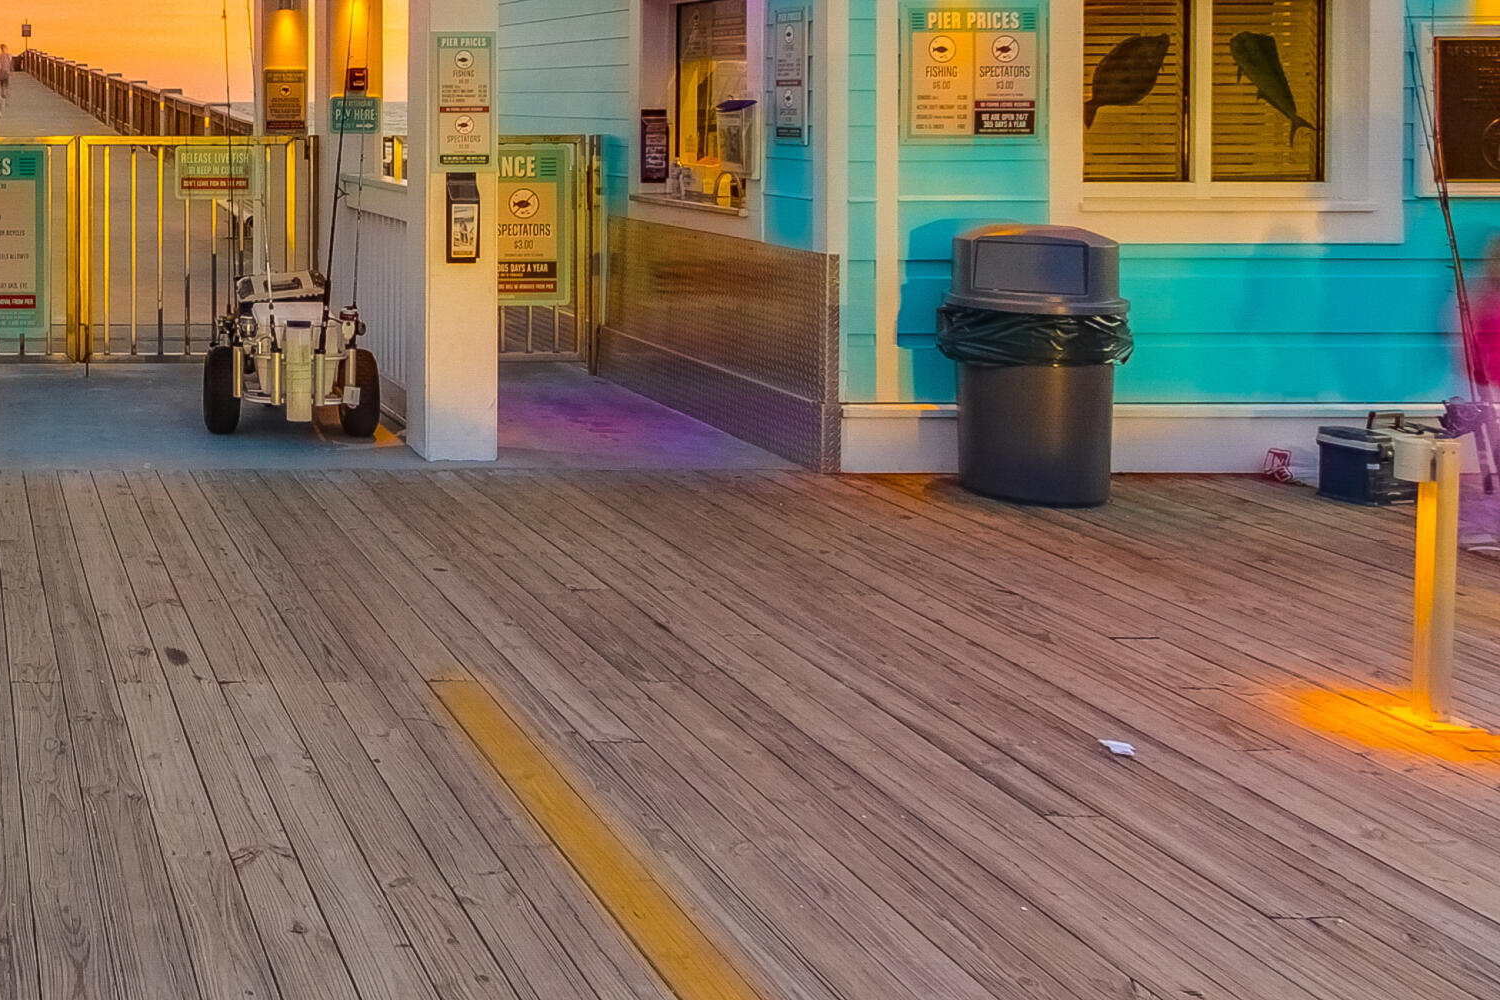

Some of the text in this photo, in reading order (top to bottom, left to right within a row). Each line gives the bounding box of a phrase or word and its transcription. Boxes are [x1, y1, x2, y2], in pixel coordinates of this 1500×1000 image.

[927, 11, 1020, 30] PIER PRICES
[441, 37, 487, 47] PIER PRICES
[925, 65, 959, 78] FISHING
[979, 65, 1031, 78] SPECTATORS
[354, 108, 375, 121] HERE
[180, 152, 249, 164] RELEASE LIVE FISH
[497, 223, 551, 237] SPECTATORS
[514, 240, 534, 249] $3.00
[510, 264, 526, 272] DAYS
[527, 264, 532, 272] A
[533, 264, 549, 272] YEAR
